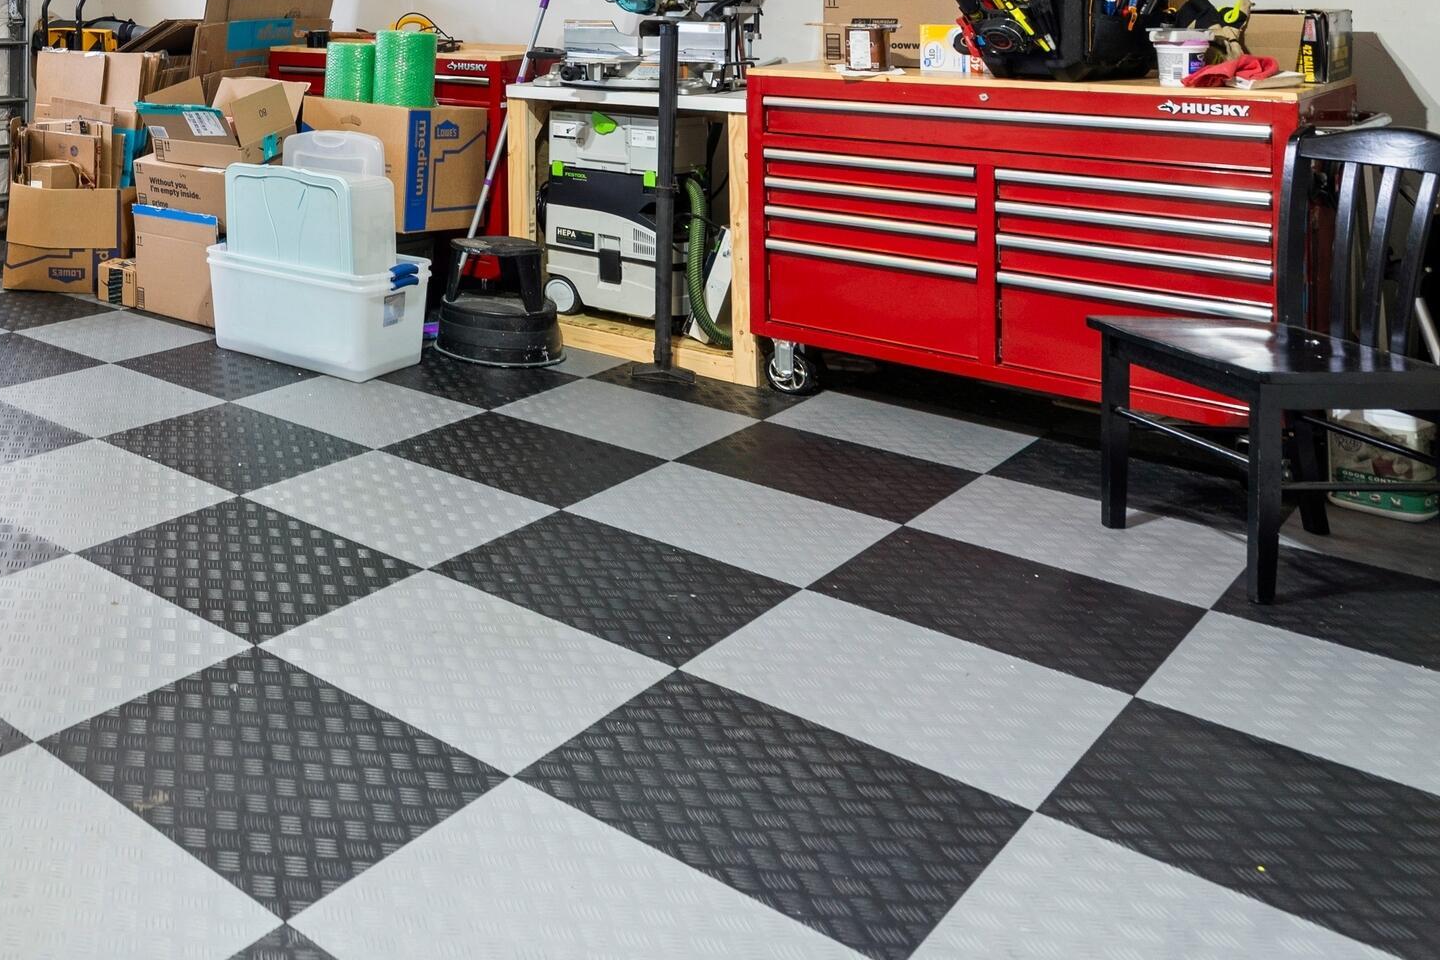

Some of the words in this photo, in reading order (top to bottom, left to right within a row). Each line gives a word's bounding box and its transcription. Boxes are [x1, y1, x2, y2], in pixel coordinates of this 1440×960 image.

[1303, 44, 1312, 55] 42
[457, 62, 487, 71] HUSKY
[1180, 101, 1250, 117] HUSKY
[436, 127, 457, 138] LOWE'S
[416, 120, 427, 196] medium
[149, 176, 174, 187] Without
[175, 182, 188, 191] you,
[150, 185, 160, 193] I'm
[160, 187, 180, 197] empty
[180, 190, 201, 200] inside.
[557, 227, 577, 238] HEPA
[51, 268, 82, 278] LOWE'S
